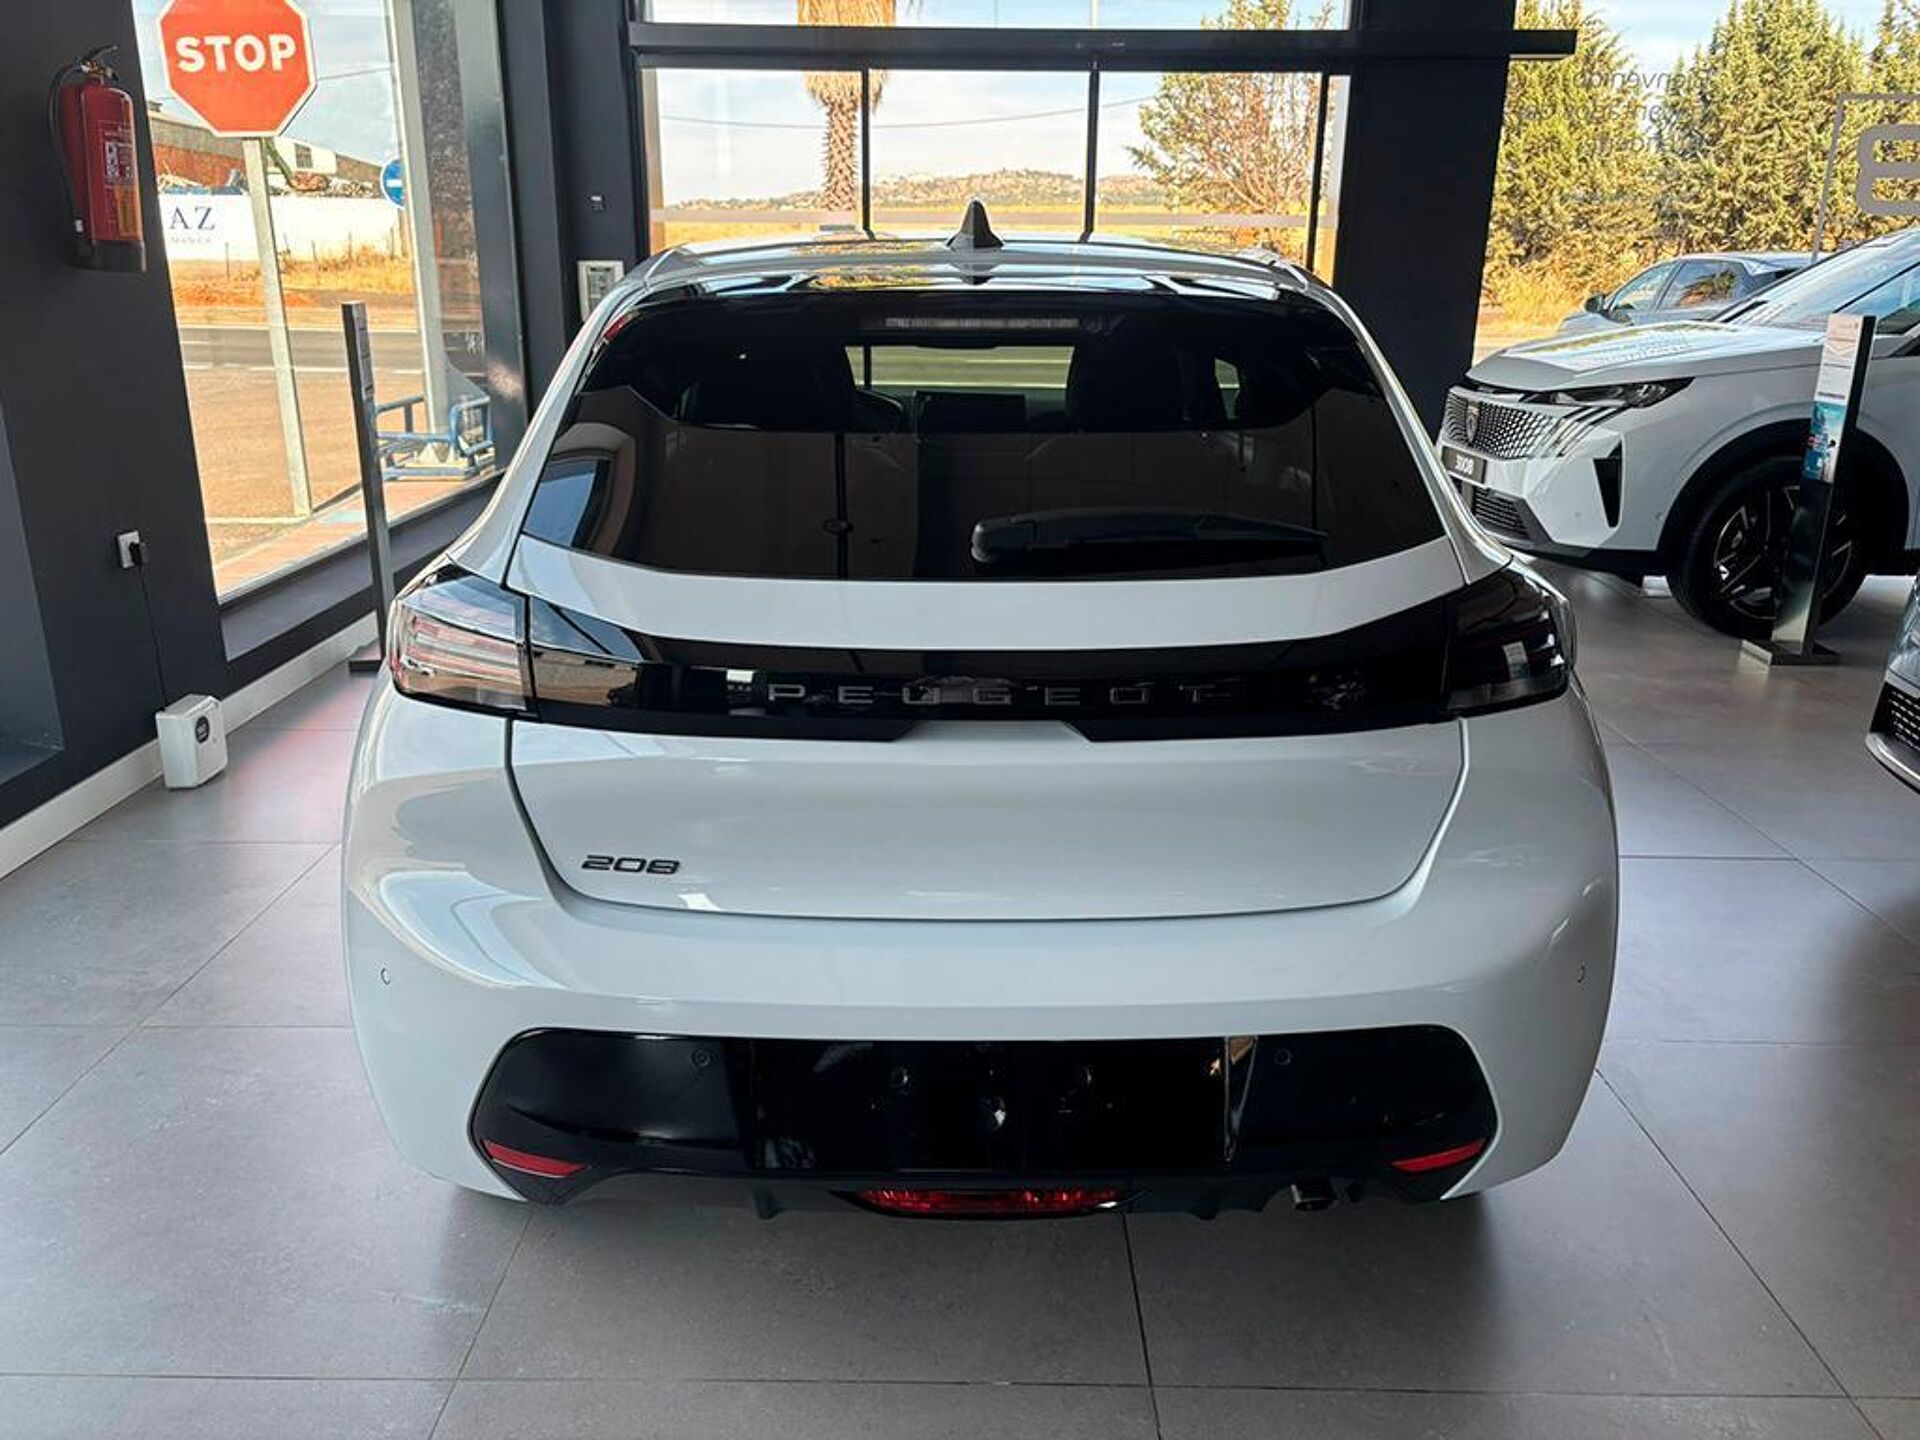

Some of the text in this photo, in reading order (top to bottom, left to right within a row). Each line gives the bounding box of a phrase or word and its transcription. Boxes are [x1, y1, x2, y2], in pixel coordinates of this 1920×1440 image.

[175, 33, 297, 73] STOP
[766, 682, 1216, 706] PEUGEOT
[581, 854, 682, 875] 208
